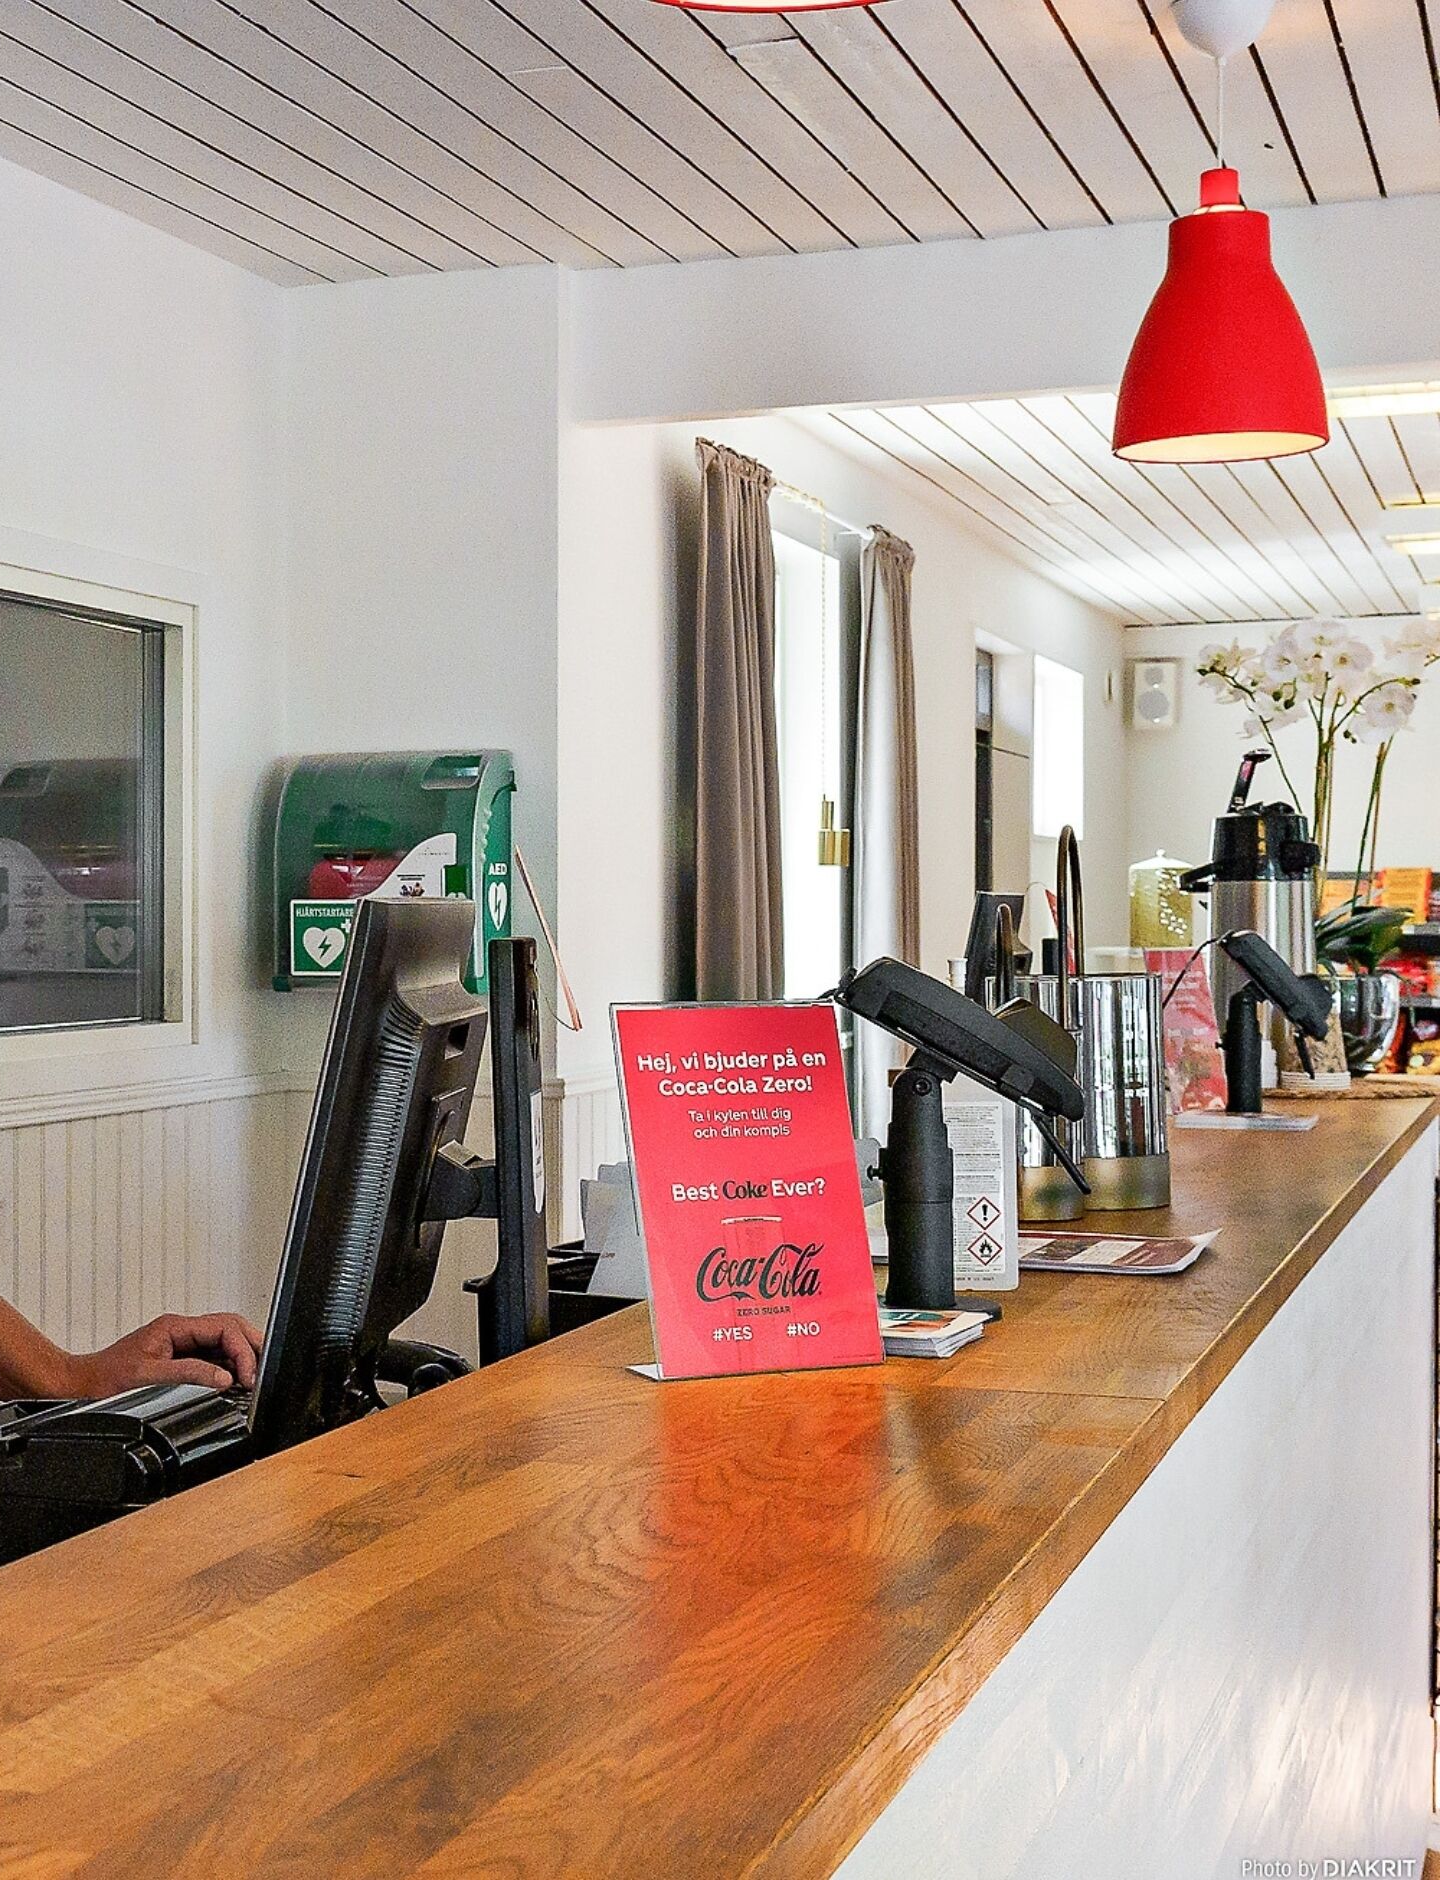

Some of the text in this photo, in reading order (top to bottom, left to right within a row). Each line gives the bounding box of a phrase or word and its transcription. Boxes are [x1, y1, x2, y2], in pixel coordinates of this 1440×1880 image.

[487, 862, 508, 876] AED
[637, 1048, 826, 1074] Hej, vi bjuder på en
[659, 1076, 812, 1097] Coca-Cola Zero!
[688, 1109, 704, 1122] Ta
[714, 1109, 748, 1123] kylen
[751, 1108, 768, 1120] till
[771, 1108, 791, 1124] dig
[694, 1123, 790, 1138] och din kompis
[672, 1178, 825, 1201] Best Coke Ever?
[737, 1306, 791, 1317] ZERO SUGAR
[713, 1322, 821, 1342] #YES #NO
